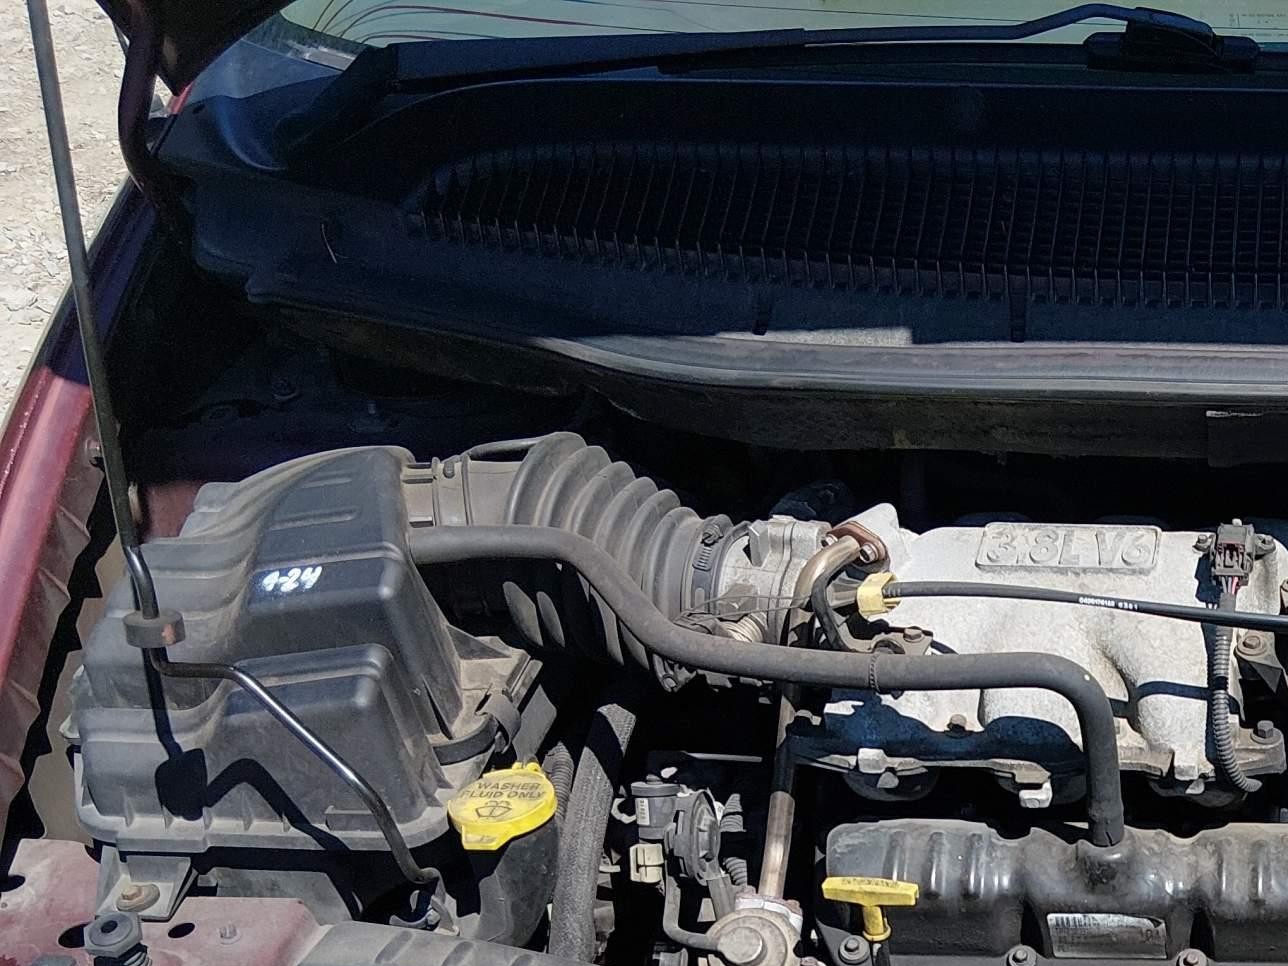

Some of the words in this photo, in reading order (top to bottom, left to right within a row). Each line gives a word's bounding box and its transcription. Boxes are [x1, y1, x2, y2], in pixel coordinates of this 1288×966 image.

[477, 782, 541, 791] WASHER
[462, 790, 504, 799] FLUID
[507, 791, 546, 799] ONLY
